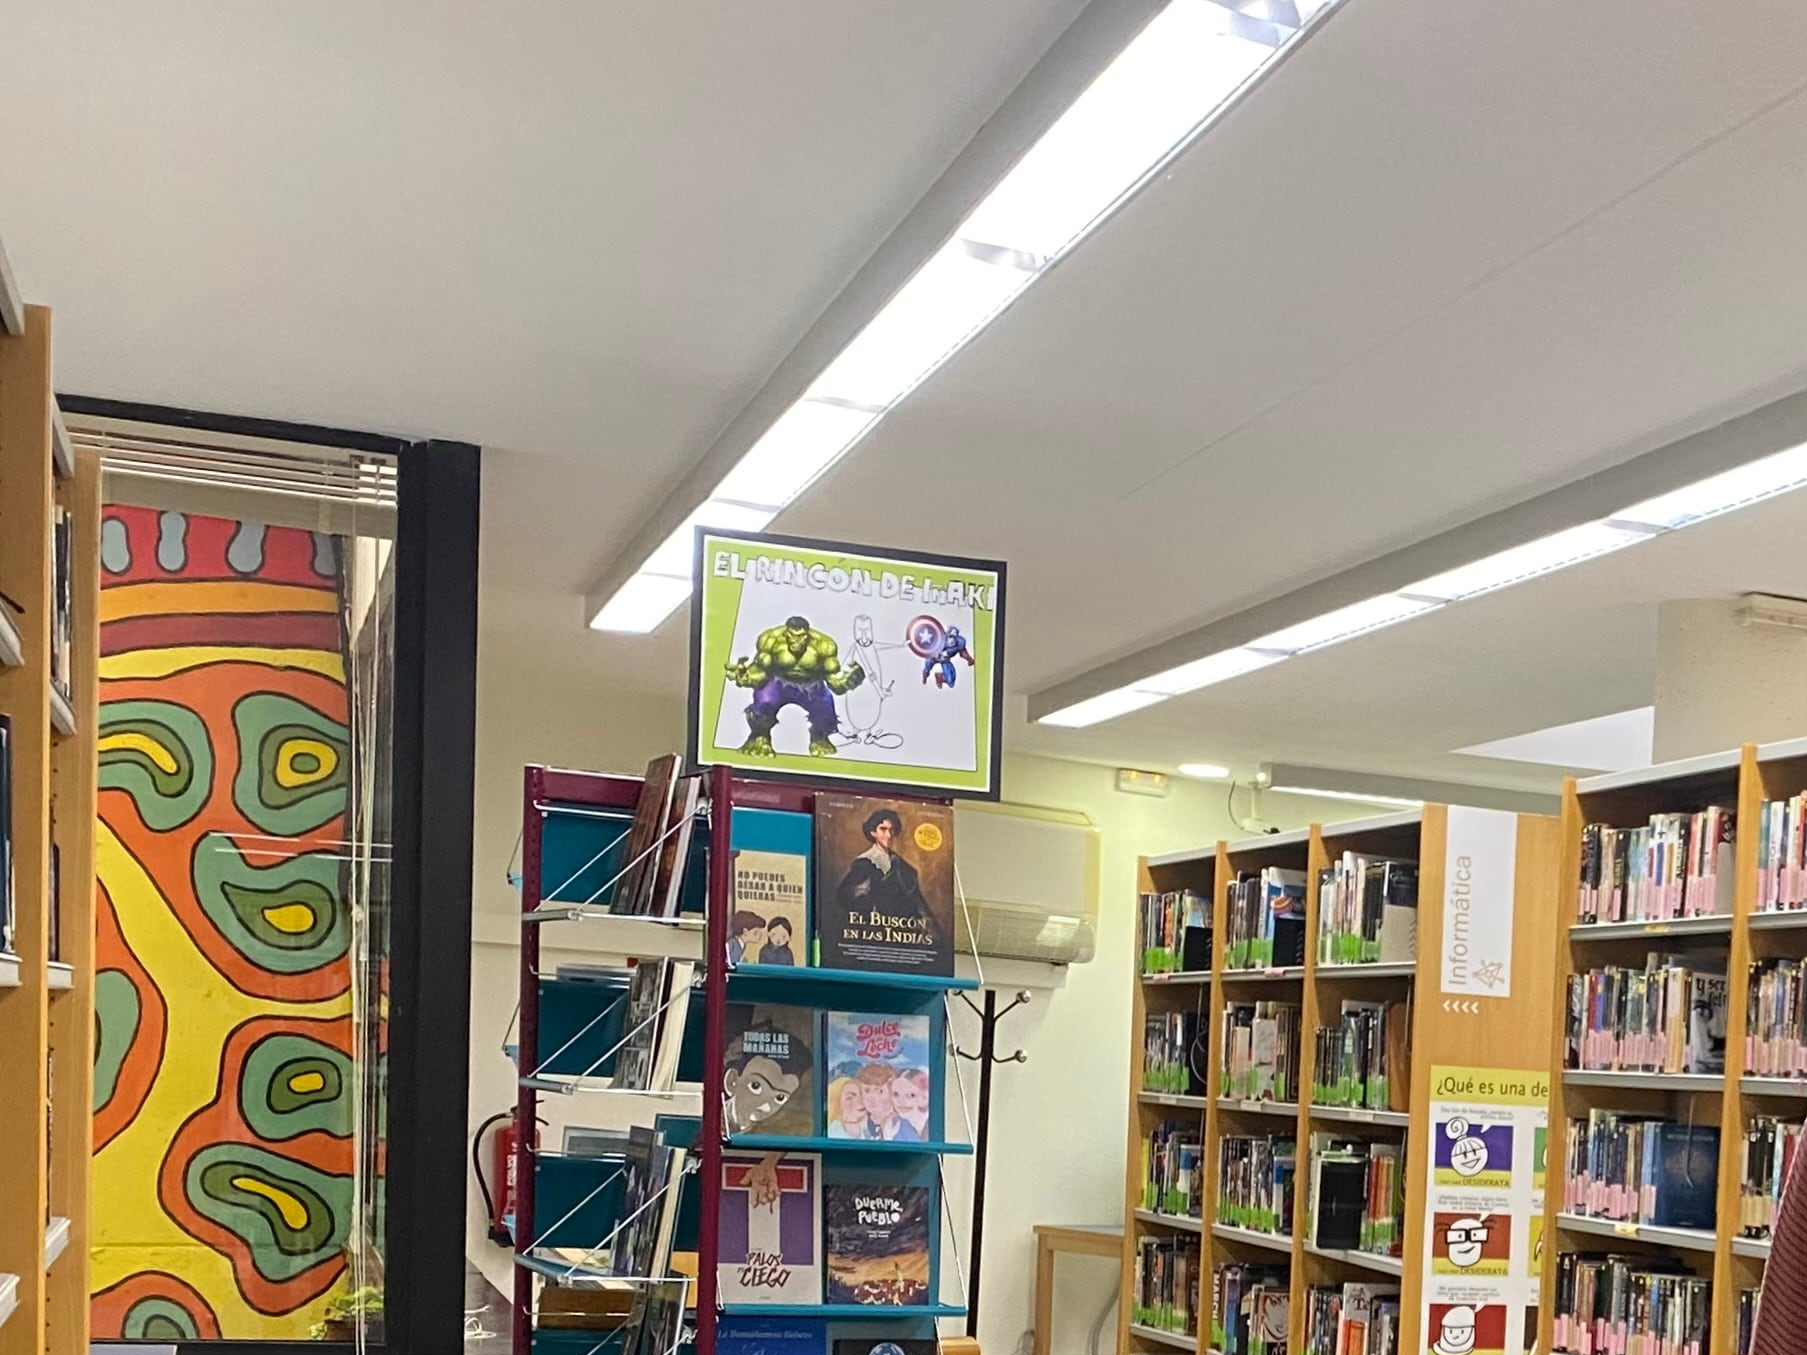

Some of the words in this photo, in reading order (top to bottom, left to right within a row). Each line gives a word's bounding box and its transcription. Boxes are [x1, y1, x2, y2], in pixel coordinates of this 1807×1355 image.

[713, 551, 746, 581] EL
[879, 571, 916, 602] DE
[1449, 855, 1473, 986] Informática
[1436, 1077, 1473, 1095] ¿Qué
[1479, 1082, 1494, 1095] es
[1500, 1084, 1526, 1096] una
